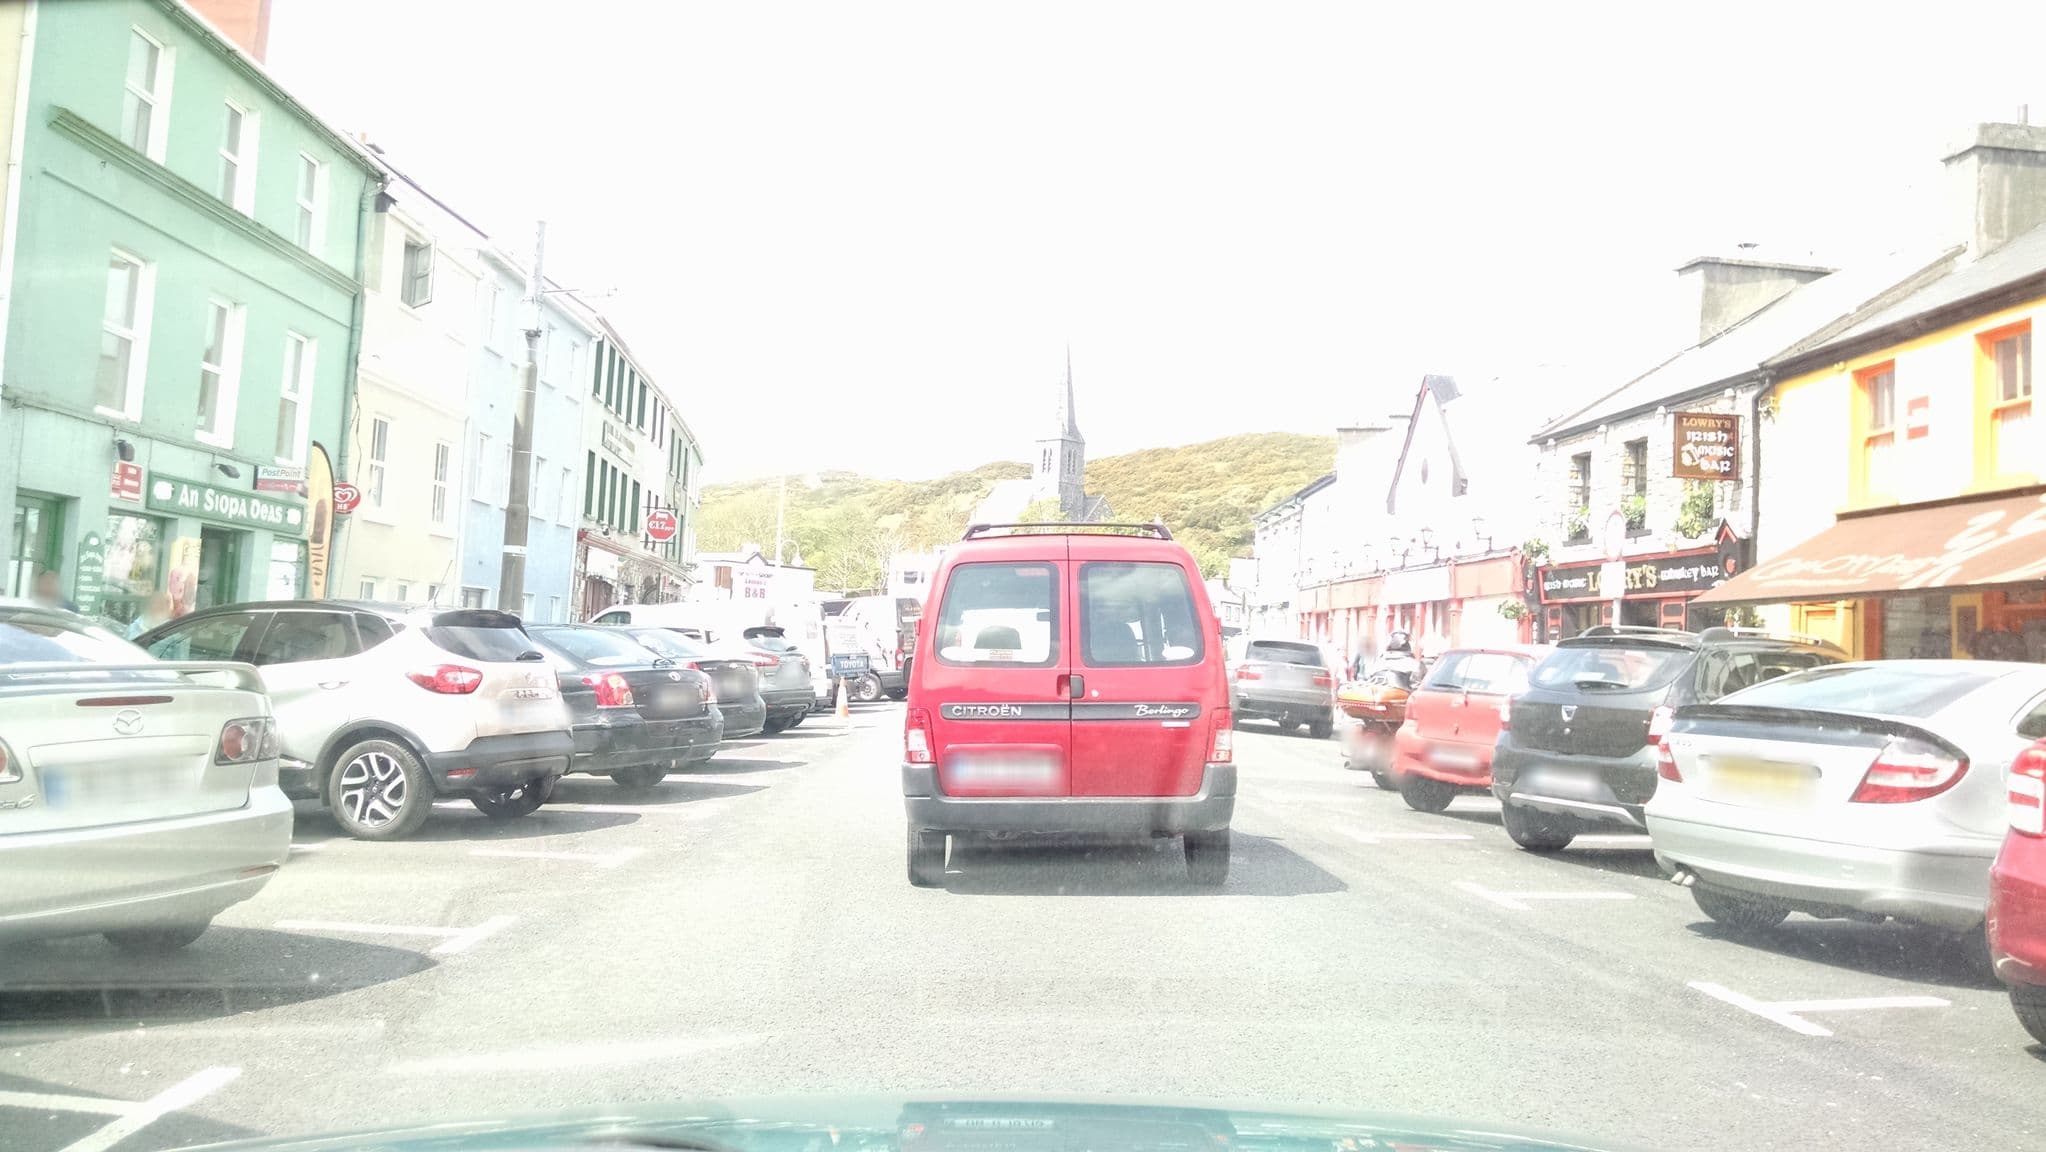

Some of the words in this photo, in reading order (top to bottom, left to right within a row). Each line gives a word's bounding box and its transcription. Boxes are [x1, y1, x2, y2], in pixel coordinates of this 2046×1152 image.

[1682, 417, 1731, 429] LOWRY'S
[262, 468, 301, 478] PostPoint
[178, 484, 199, 507] An
[1587, 564, 1658, 593] LORY'S
[951, 704, 1022, 717] CITROËN
[1134, 703, 1190, 718] Berlingo
